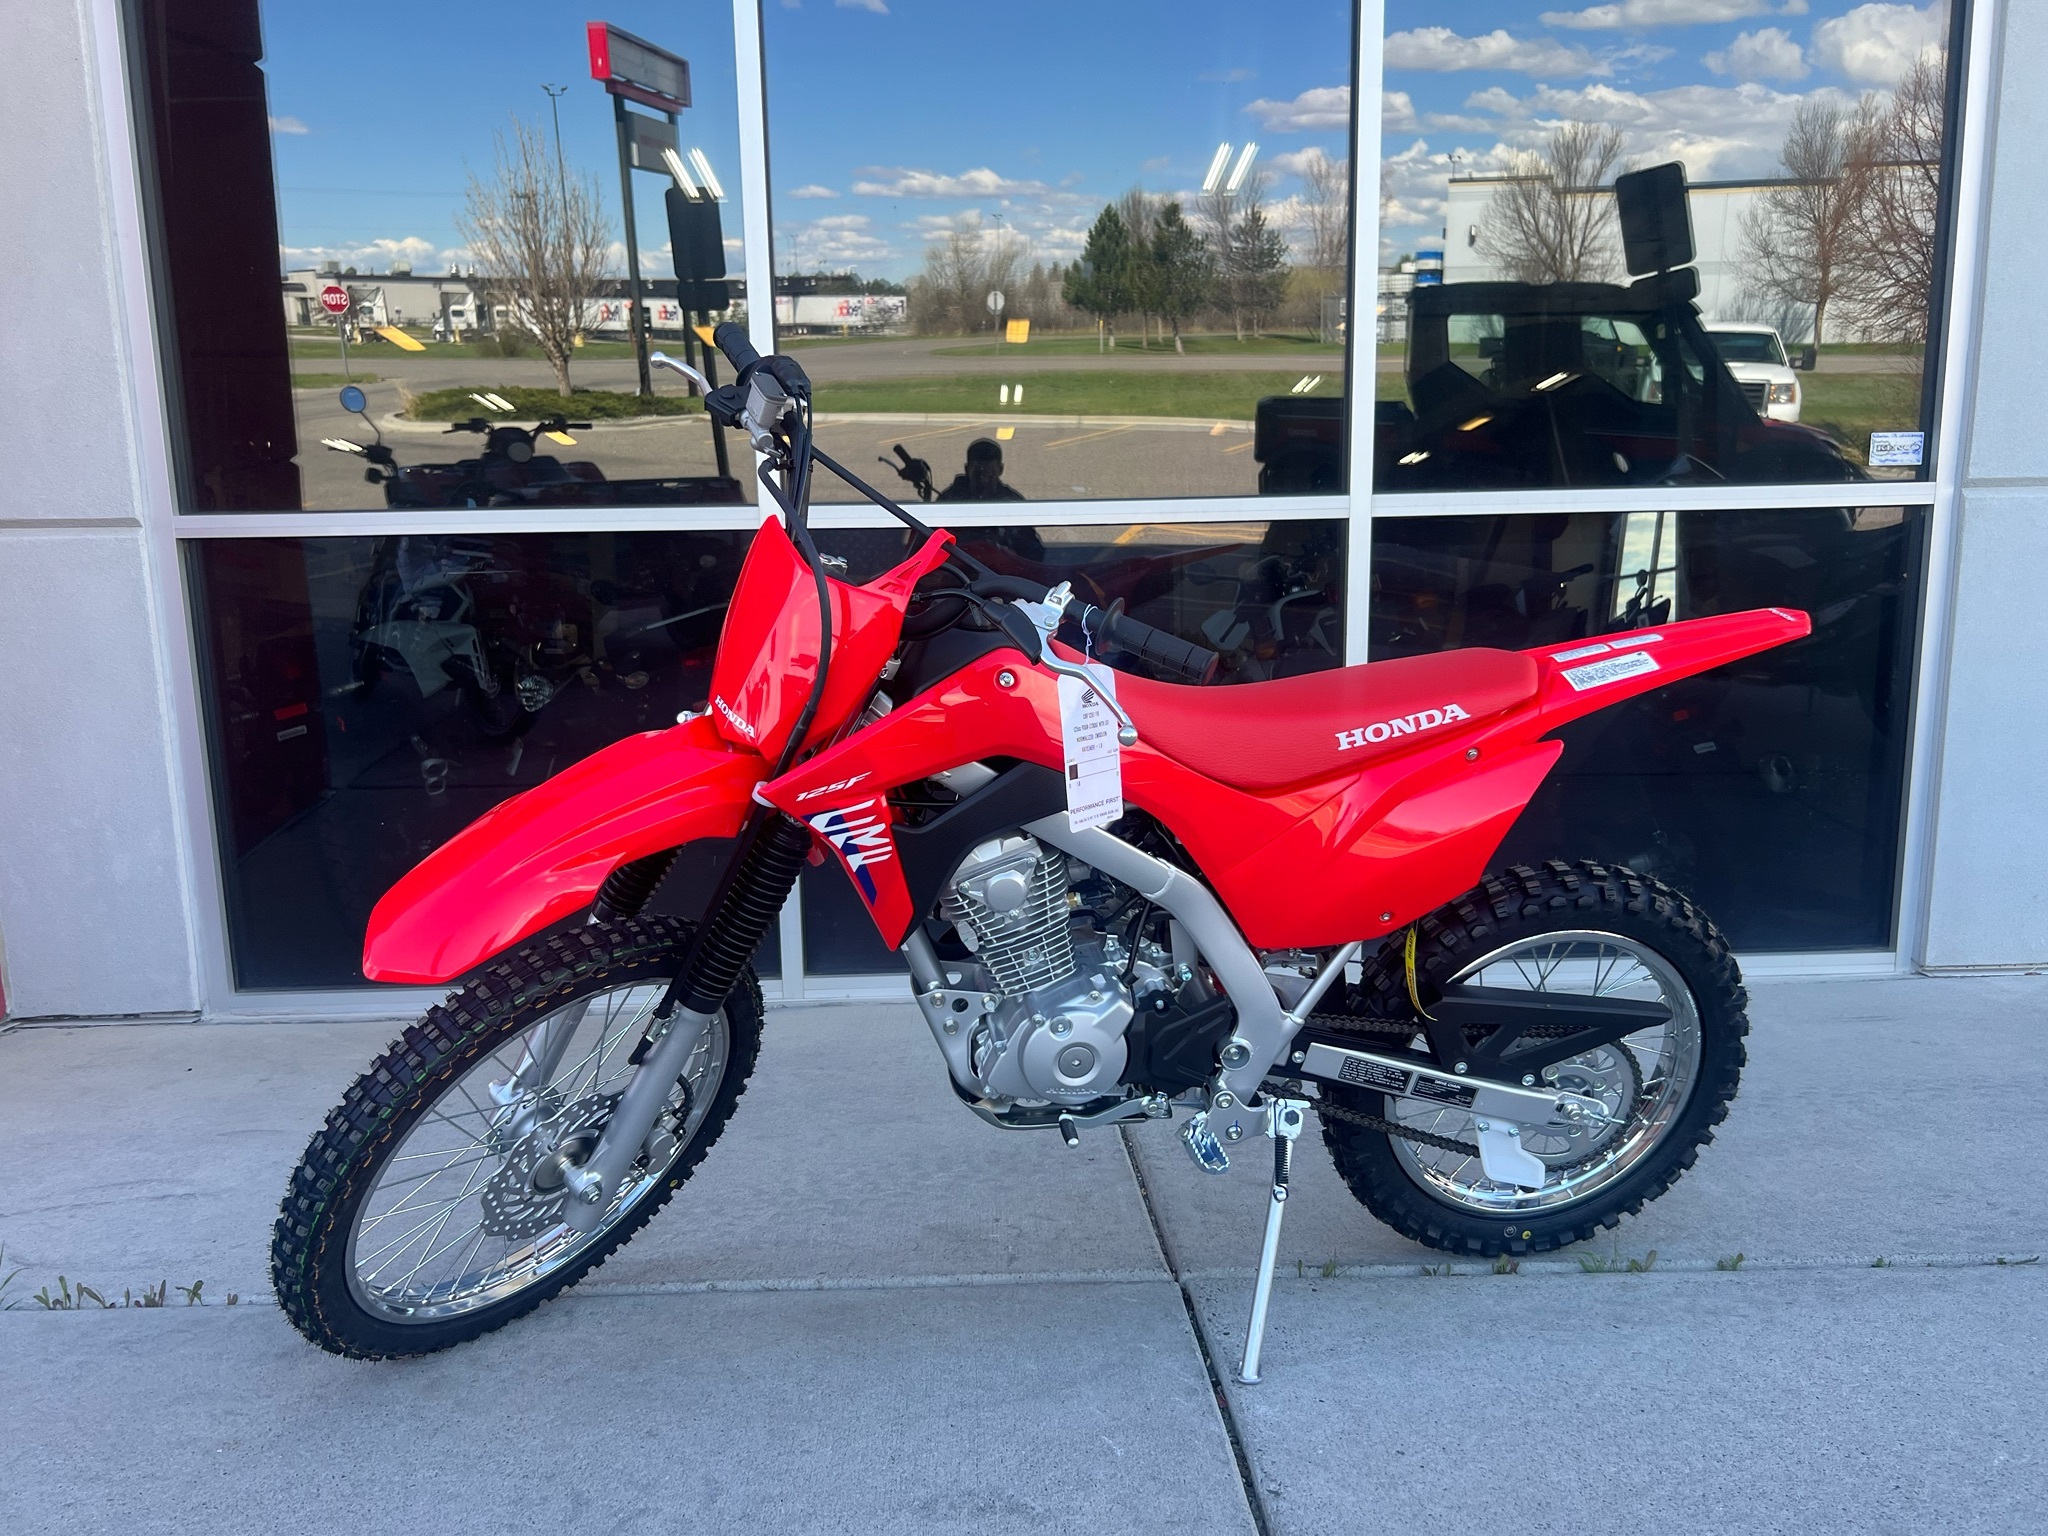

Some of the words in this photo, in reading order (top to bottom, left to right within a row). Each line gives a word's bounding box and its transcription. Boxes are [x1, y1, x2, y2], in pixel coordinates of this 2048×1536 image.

[715, 695, 755, 738] HONDA
[1334, 703, 1471, 751] HONDA
[796, 771, 873, 802] 125F
[1070, 800, 1104, 814] PERFORMANCE
[1105, 796, 1118, 804] FIRST
